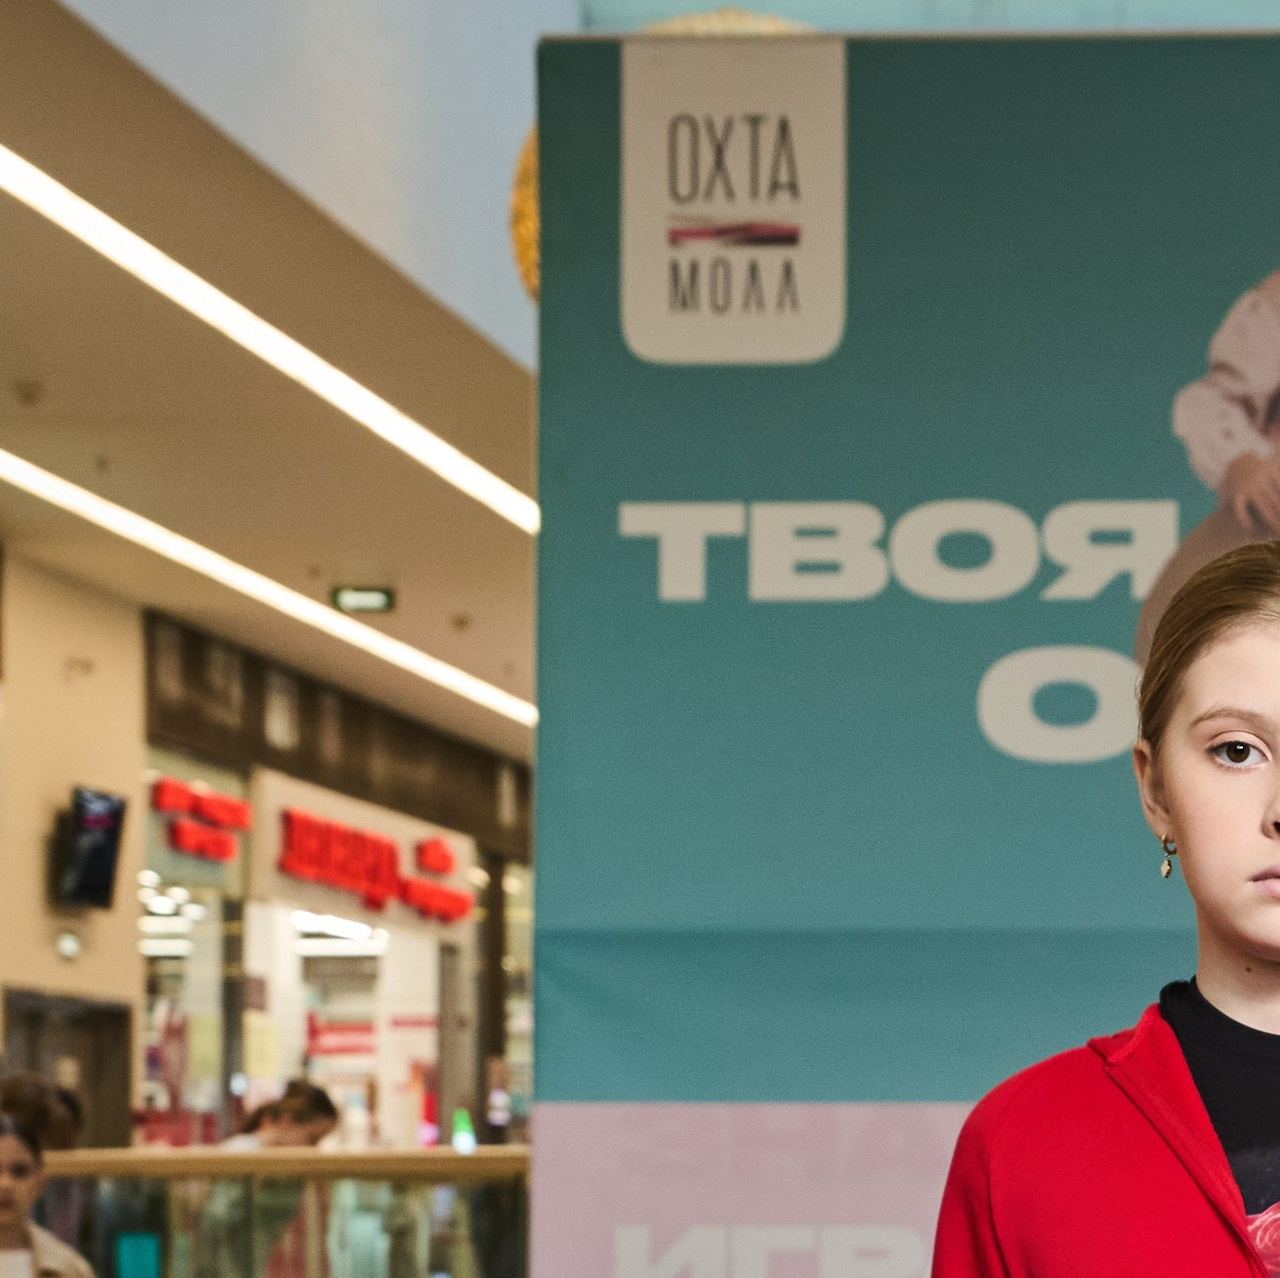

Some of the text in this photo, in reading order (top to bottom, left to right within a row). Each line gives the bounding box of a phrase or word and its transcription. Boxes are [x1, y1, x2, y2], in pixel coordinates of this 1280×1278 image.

[667, 112, 801, 203] ОХТА
[668, 256, 801, 315] МОЛЛ
[617, 498, 1180, 602] ТВОЯ
